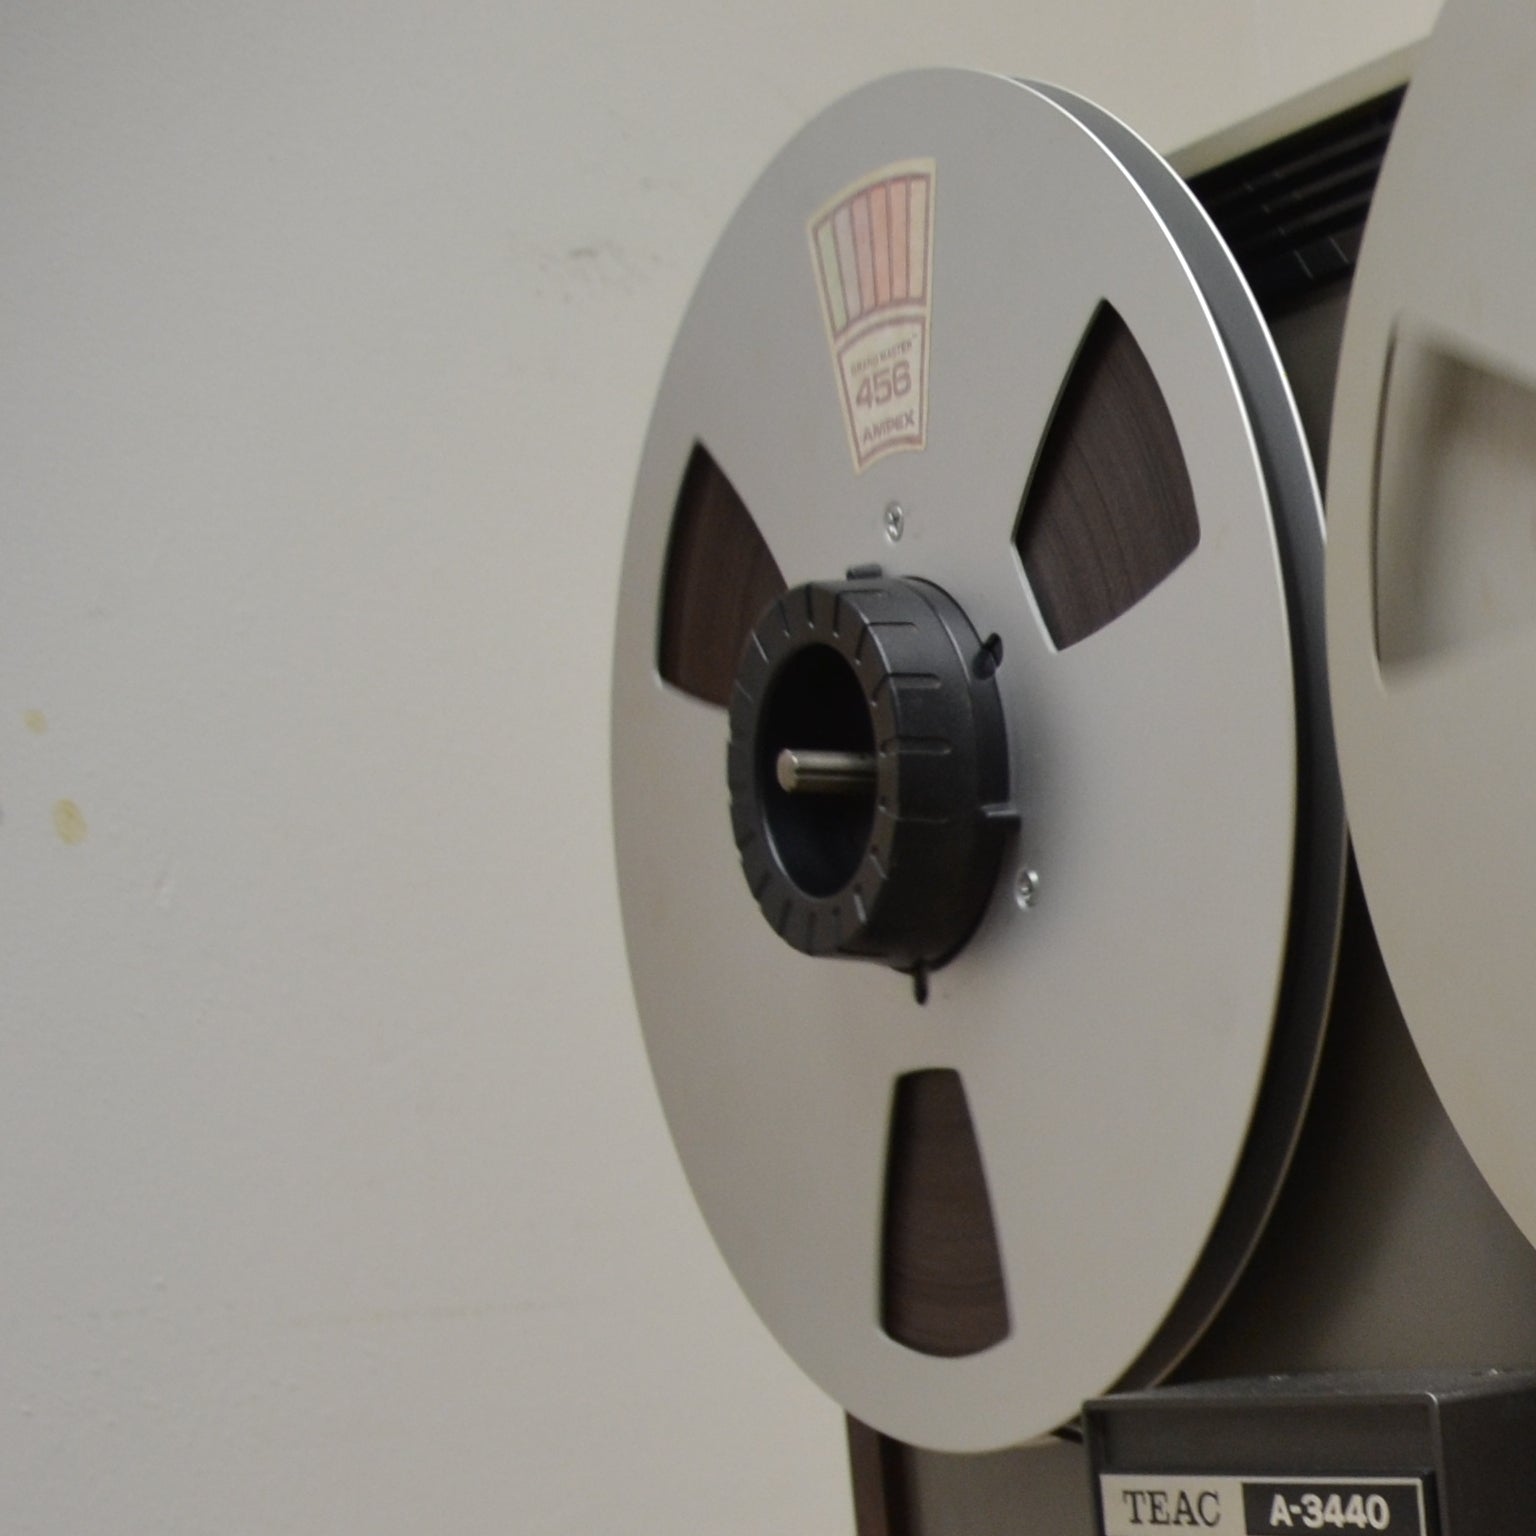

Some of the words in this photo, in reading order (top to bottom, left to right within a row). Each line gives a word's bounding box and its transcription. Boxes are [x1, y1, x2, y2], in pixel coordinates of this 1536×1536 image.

[856, 360, 912, 408] 456
[863, 409, 915, 443] AMPEX
[1122, 1490, 1221, 1527] TEAC
[1270, 1494, 1390, 1530] A-3440
